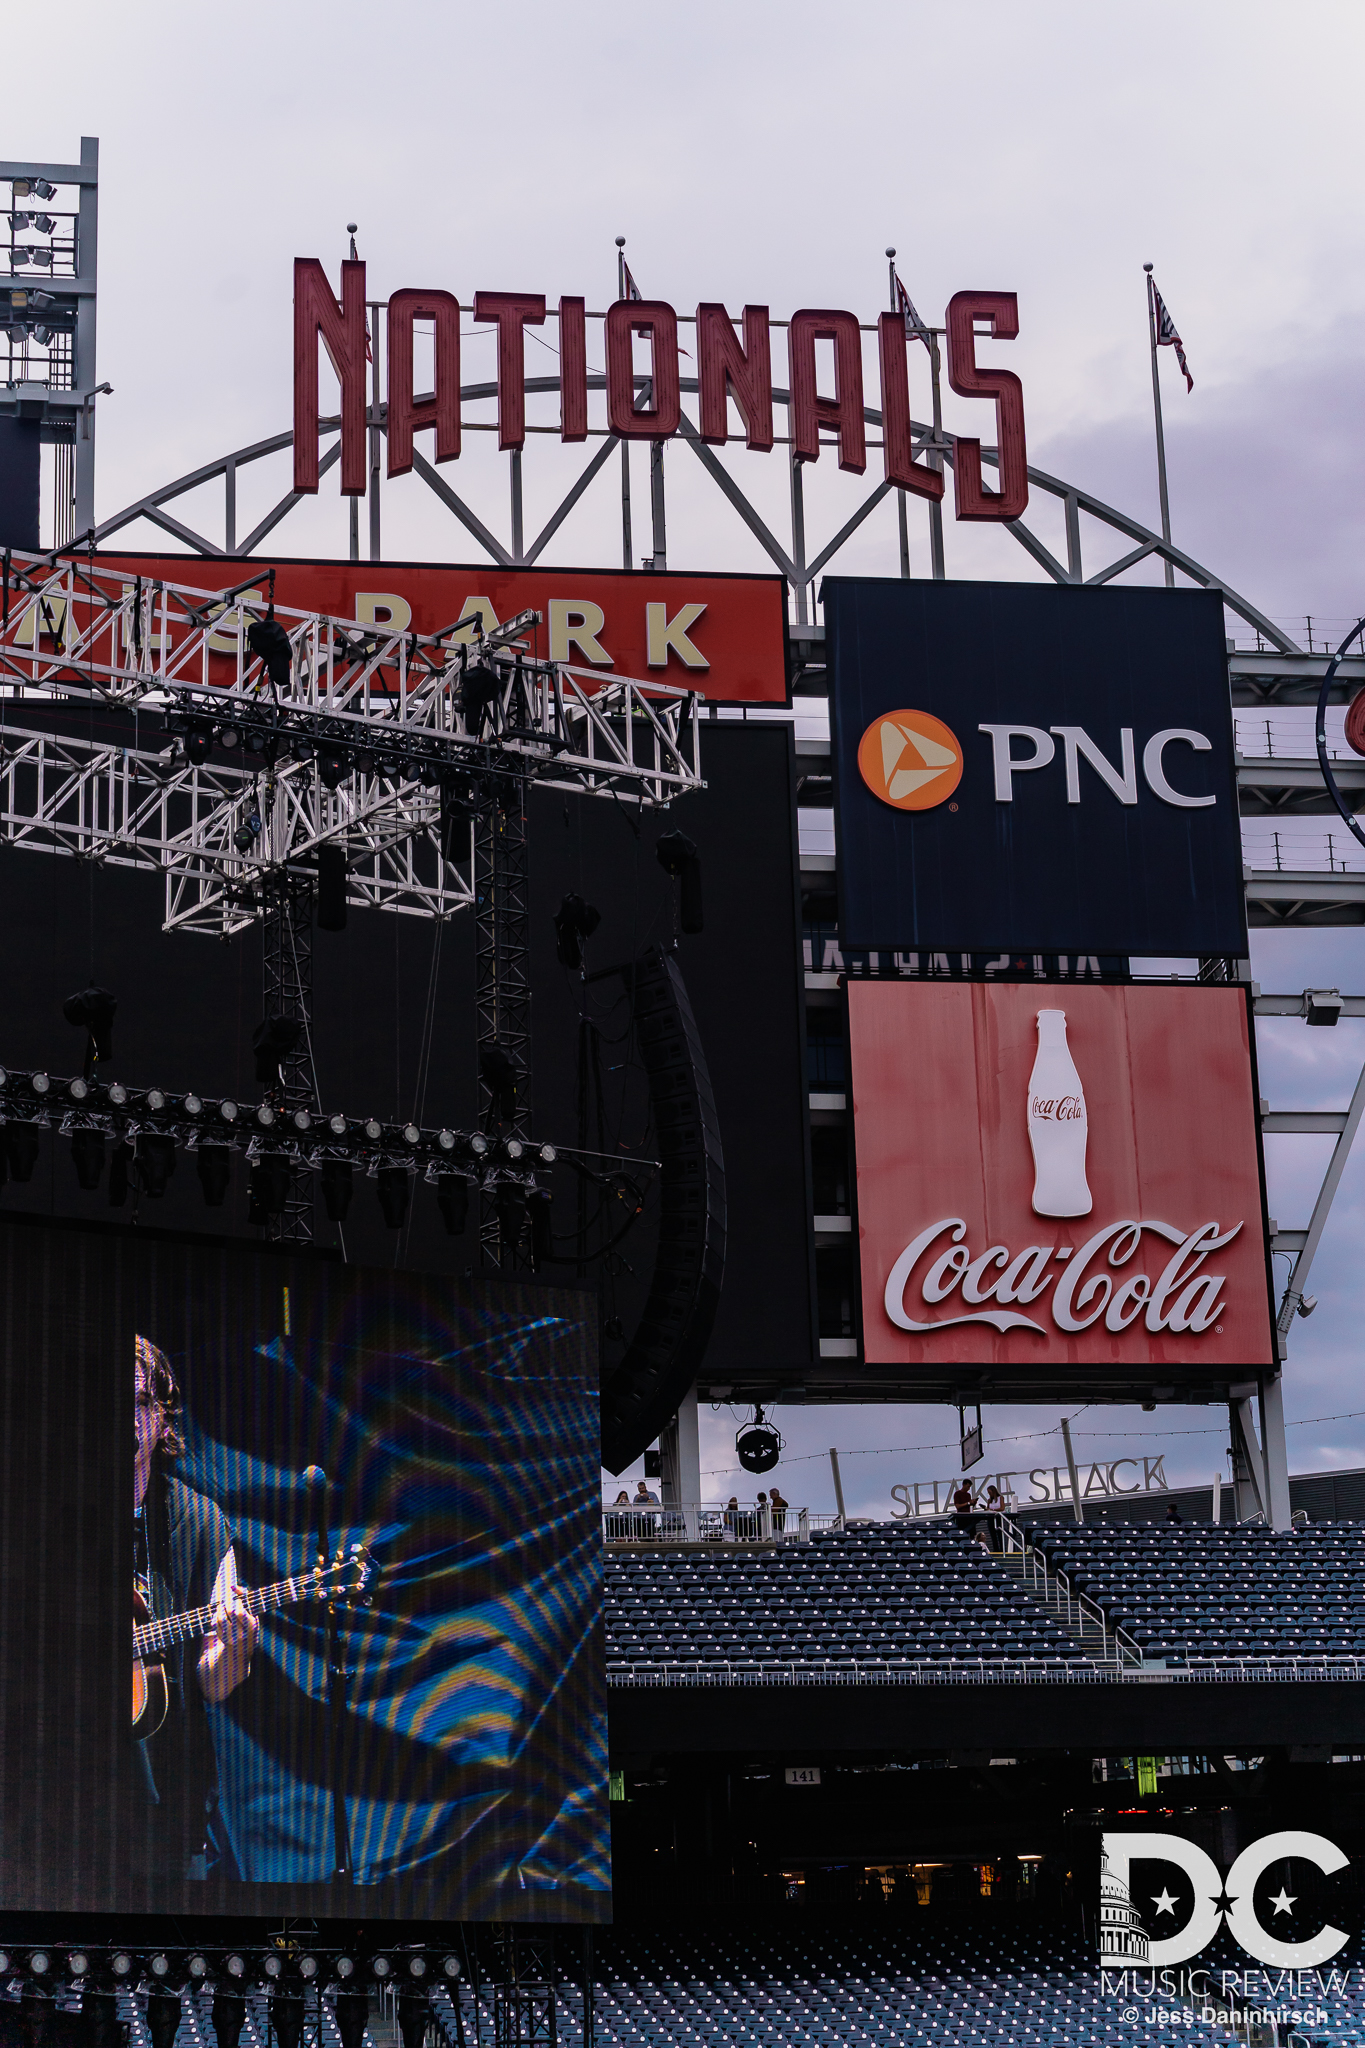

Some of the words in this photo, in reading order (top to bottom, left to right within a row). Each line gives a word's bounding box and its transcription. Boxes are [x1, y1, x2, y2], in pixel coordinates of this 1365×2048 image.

[293, 257, 1029, 522] NATIONALS
[354, 592, 711, 669] PARK
[978, 724, 1217, 808] PNC
[1032, 1095, 1083, 1121] Coca-Cola
[884, 1217, 1244, 1335] Coca-Cola
[1028, 1454, 1169, 1503] SHACK
[791, 1770, 816, 1782] 141
